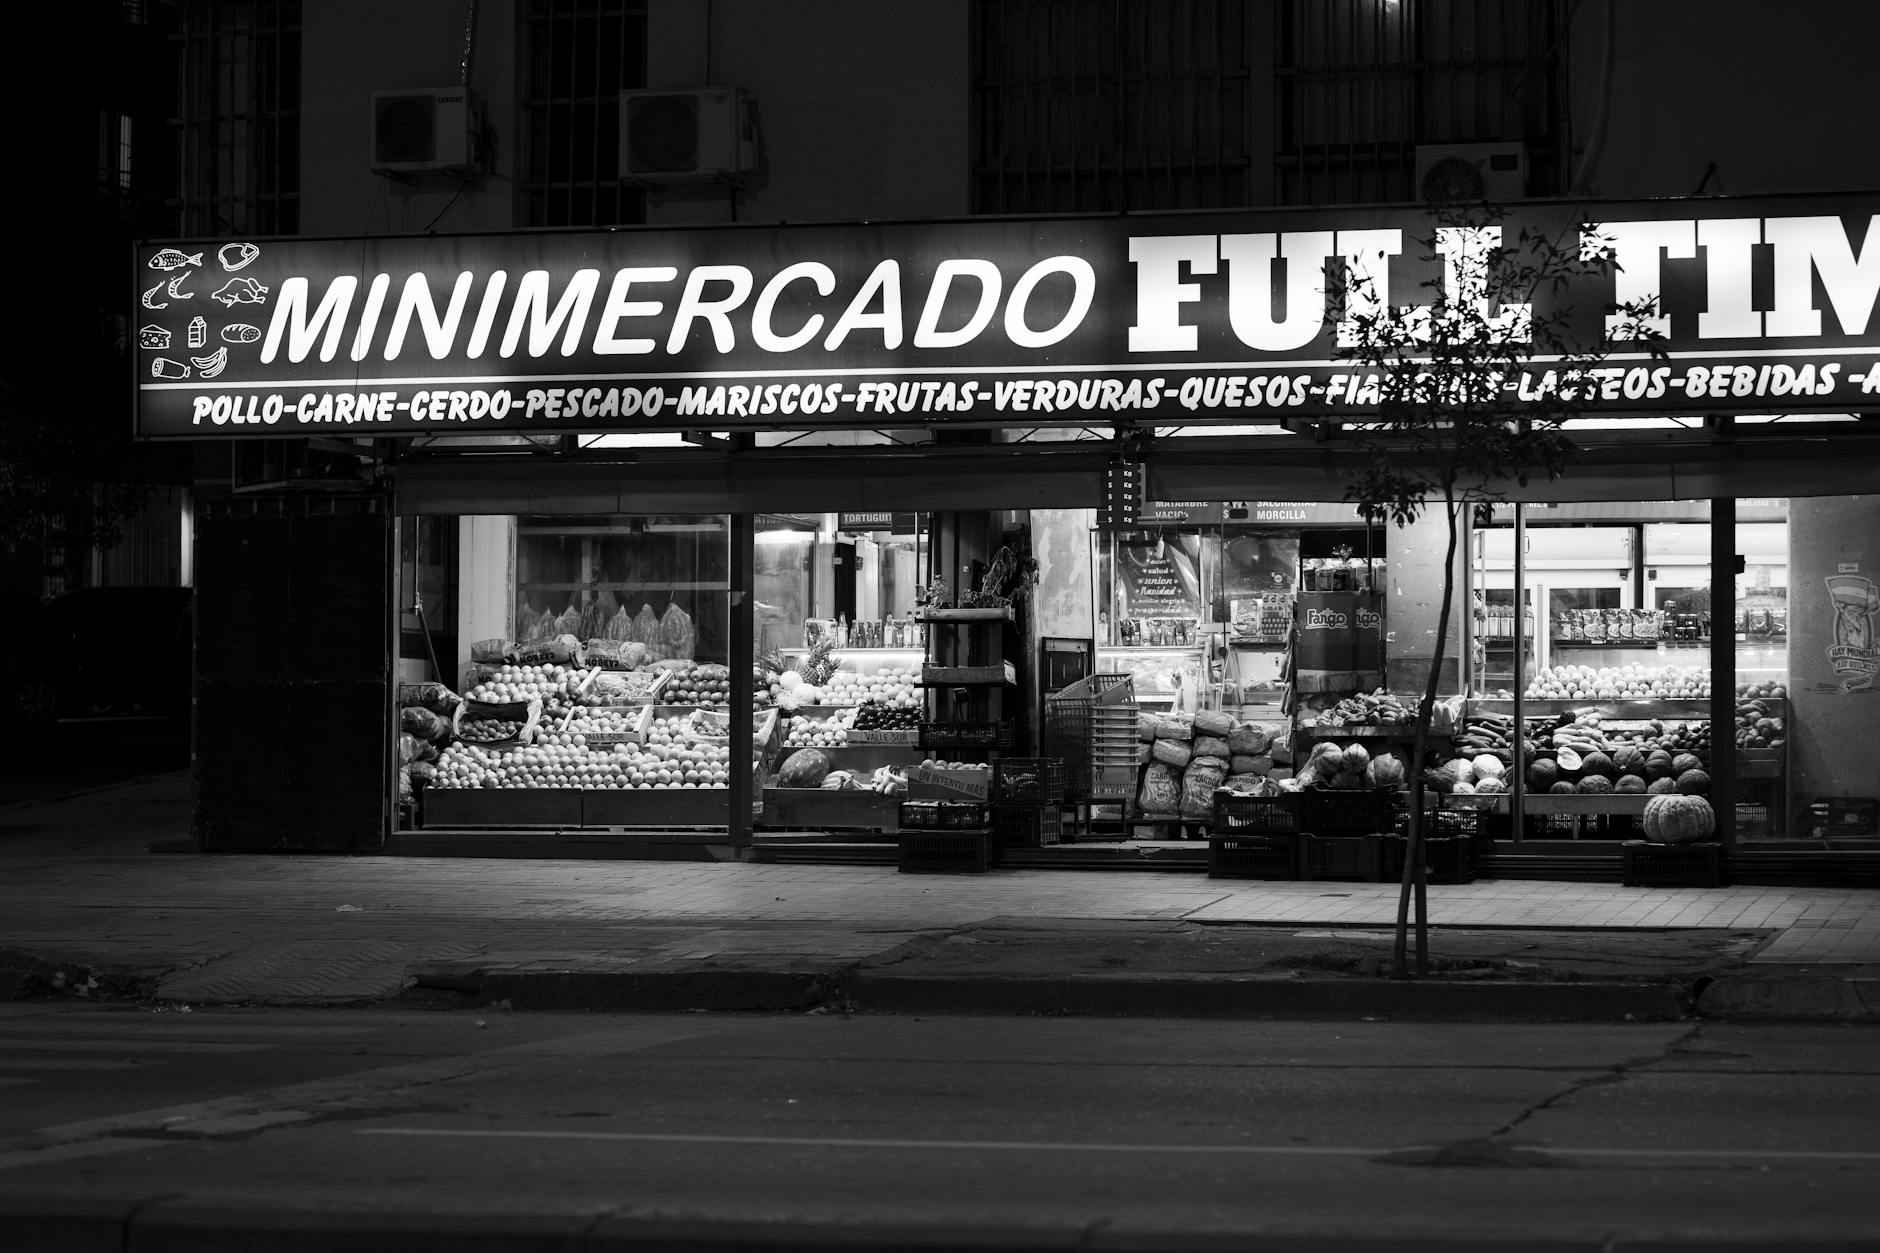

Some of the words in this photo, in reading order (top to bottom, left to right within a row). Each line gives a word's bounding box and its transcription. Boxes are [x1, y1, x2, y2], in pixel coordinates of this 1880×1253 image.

[260, 256, 1096, 365] MINIMERCADO
[1128, 226, 1534, 353] FULL
[1685, 362, 1841, 399] BEBIDAS
[1256, 510, 1306, 520] MORCILLA
